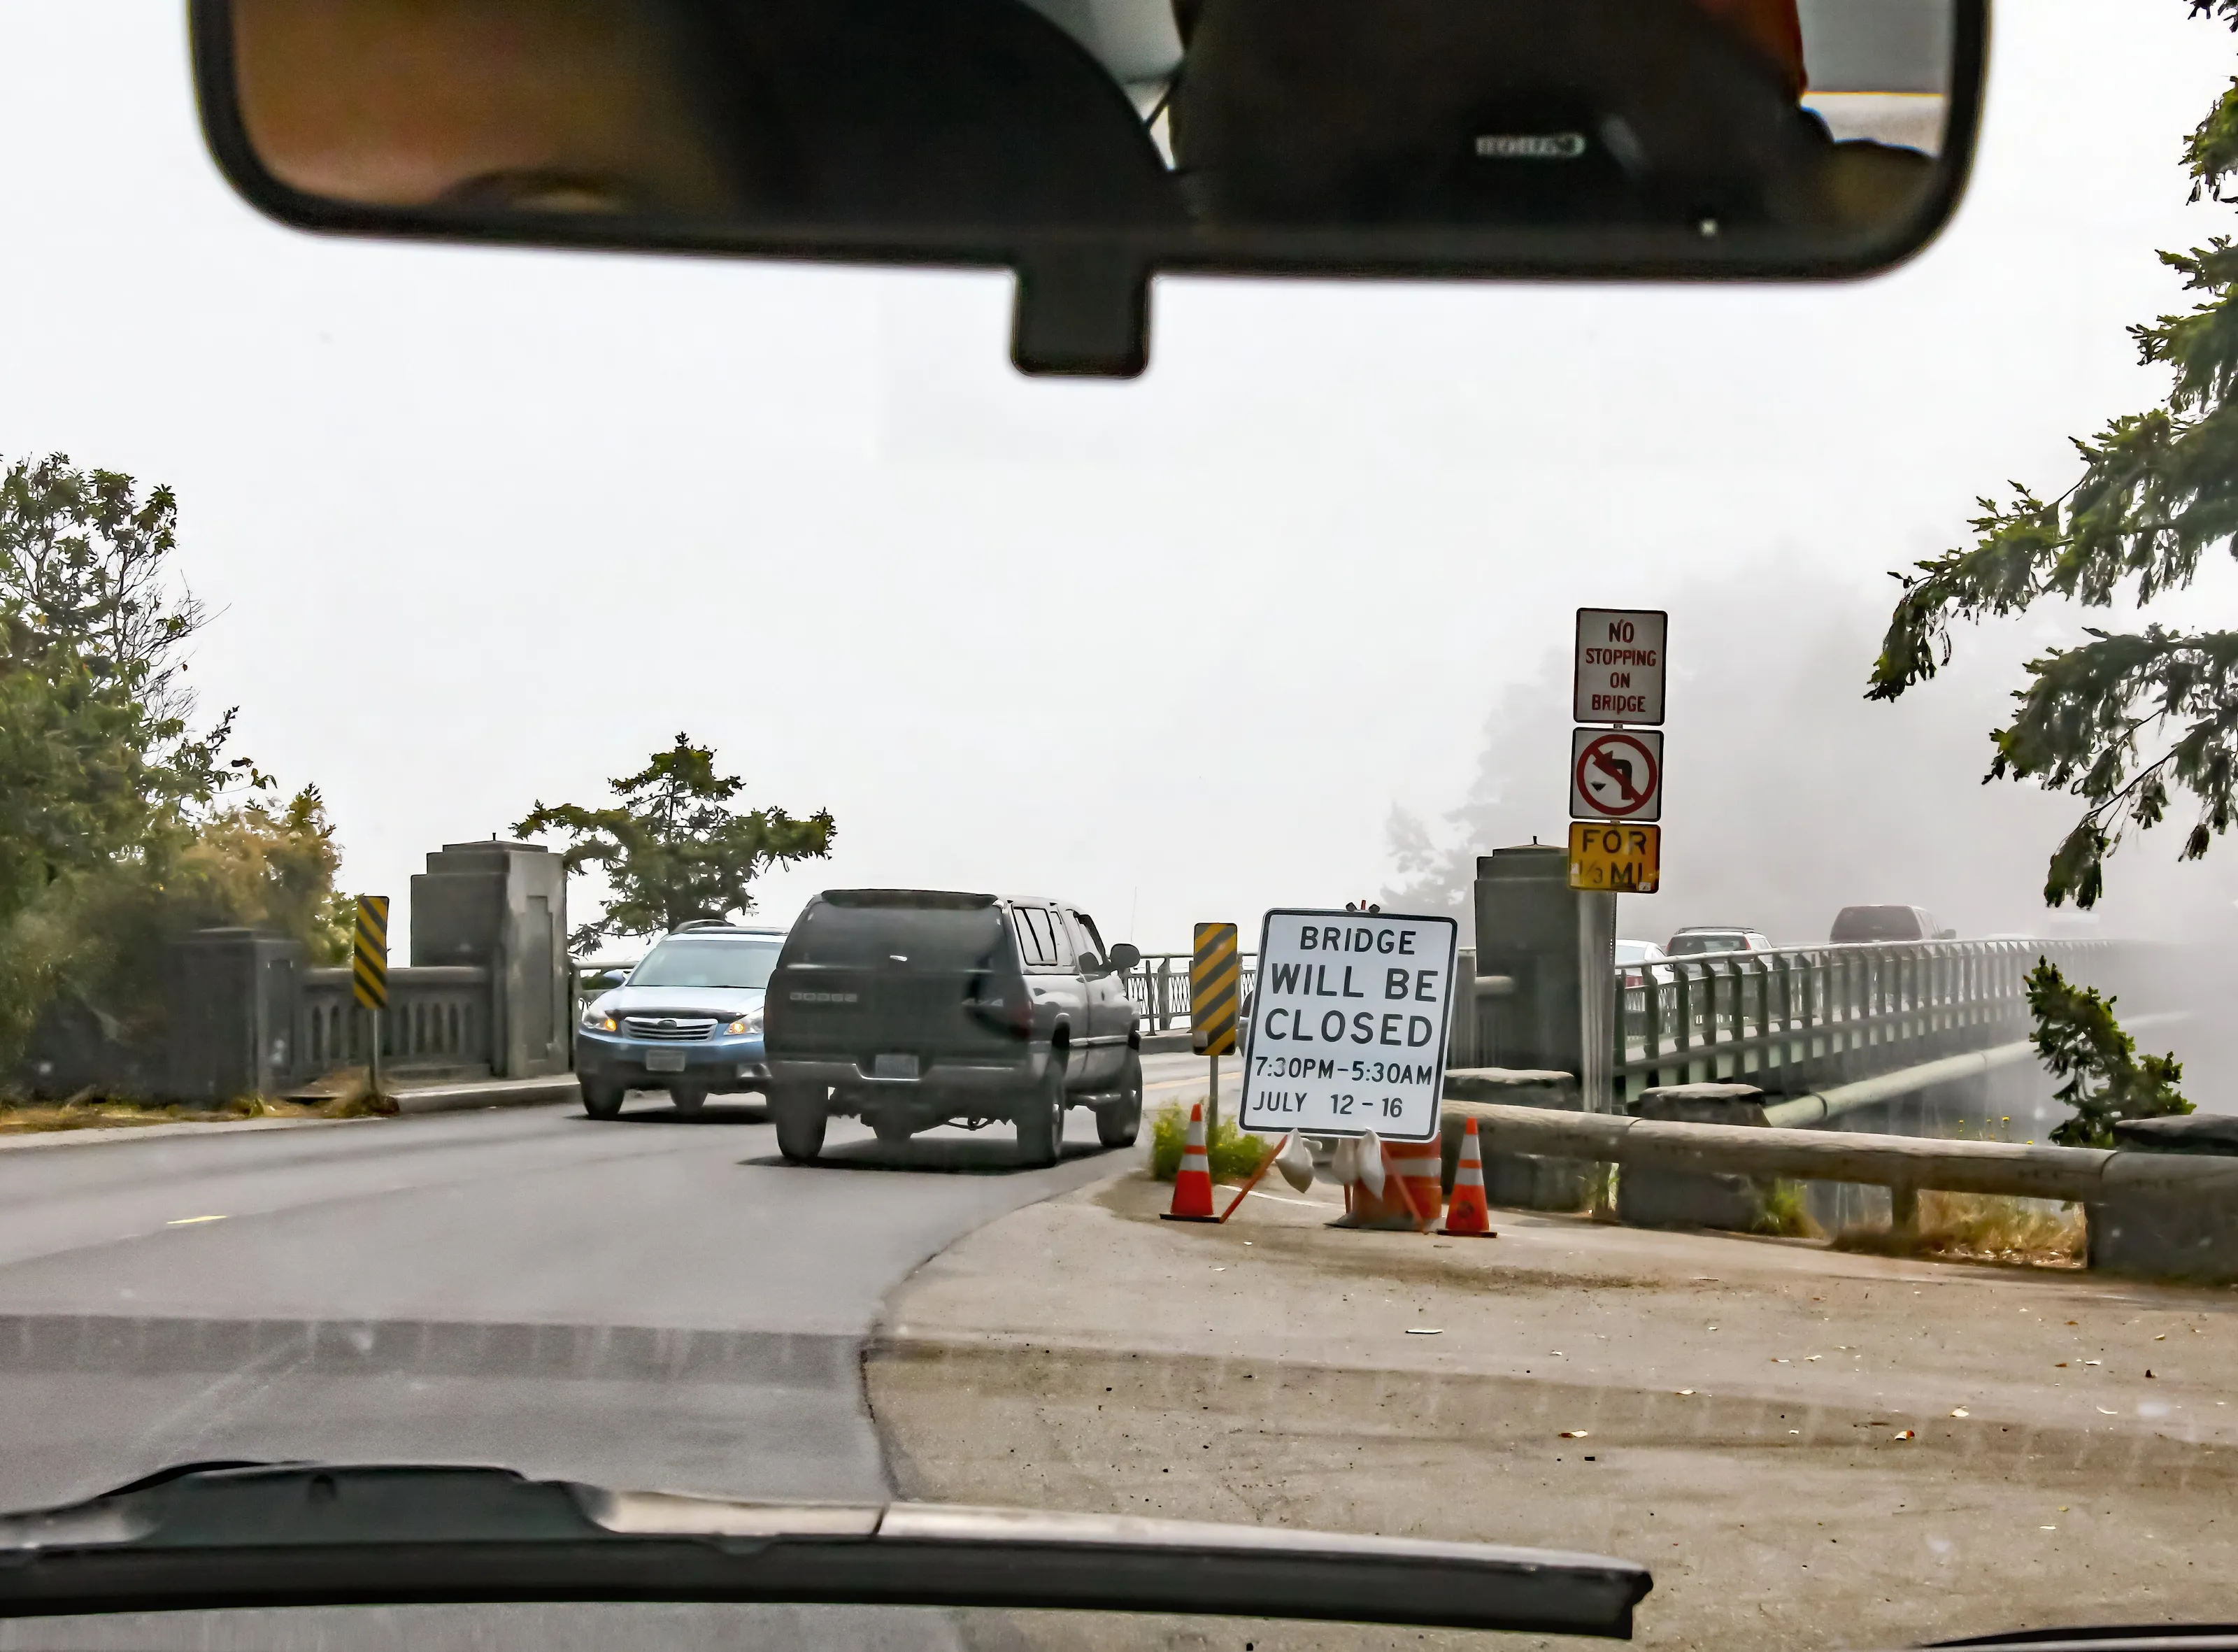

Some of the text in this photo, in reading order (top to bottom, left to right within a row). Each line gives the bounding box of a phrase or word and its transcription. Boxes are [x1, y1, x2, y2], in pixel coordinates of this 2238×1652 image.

[1609, 619, 1634, 643] NO
[1585, 648, 1657, 667] STOPPING
[1610, 671, 1630, 688] ON
[1592, 695, 1646, 713] BRIDGE
[1582, 829, 1646, 855] FOR
[1611, 862, 1643, 885] MI
[1299, 926, 1416, 955] BRIDGE
[1271, 963, 1438, 1002] WILL BE
[1265, 1008, 1432, 1048] CLOSED
[1253, 1091, 1307, 1112] JULY
